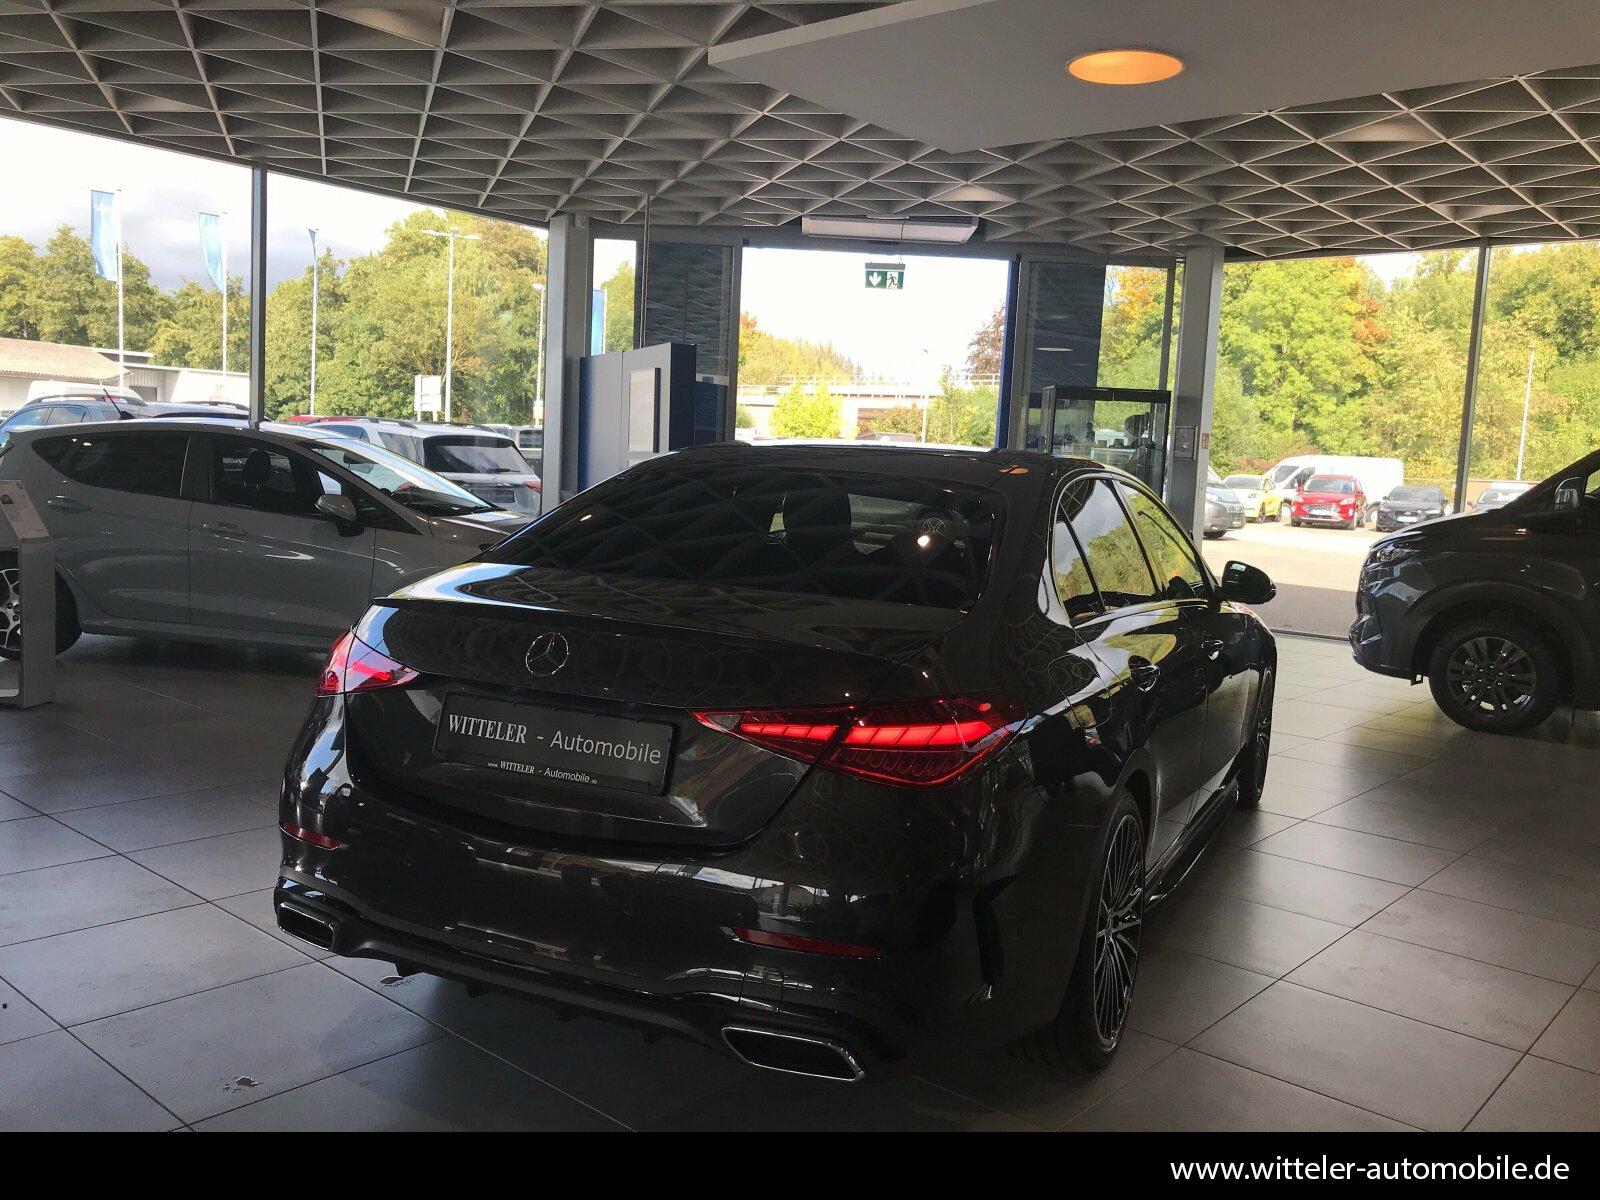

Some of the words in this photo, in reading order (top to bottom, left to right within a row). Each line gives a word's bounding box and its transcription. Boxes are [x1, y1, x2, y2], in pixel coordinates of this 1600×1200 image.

[448, 714, 527, 744] WITTELER
[549, 730, 661, 765] Automobile
[500, 760, 535, 774] WITTELER
[543, 767, 590, 783] Automobile
